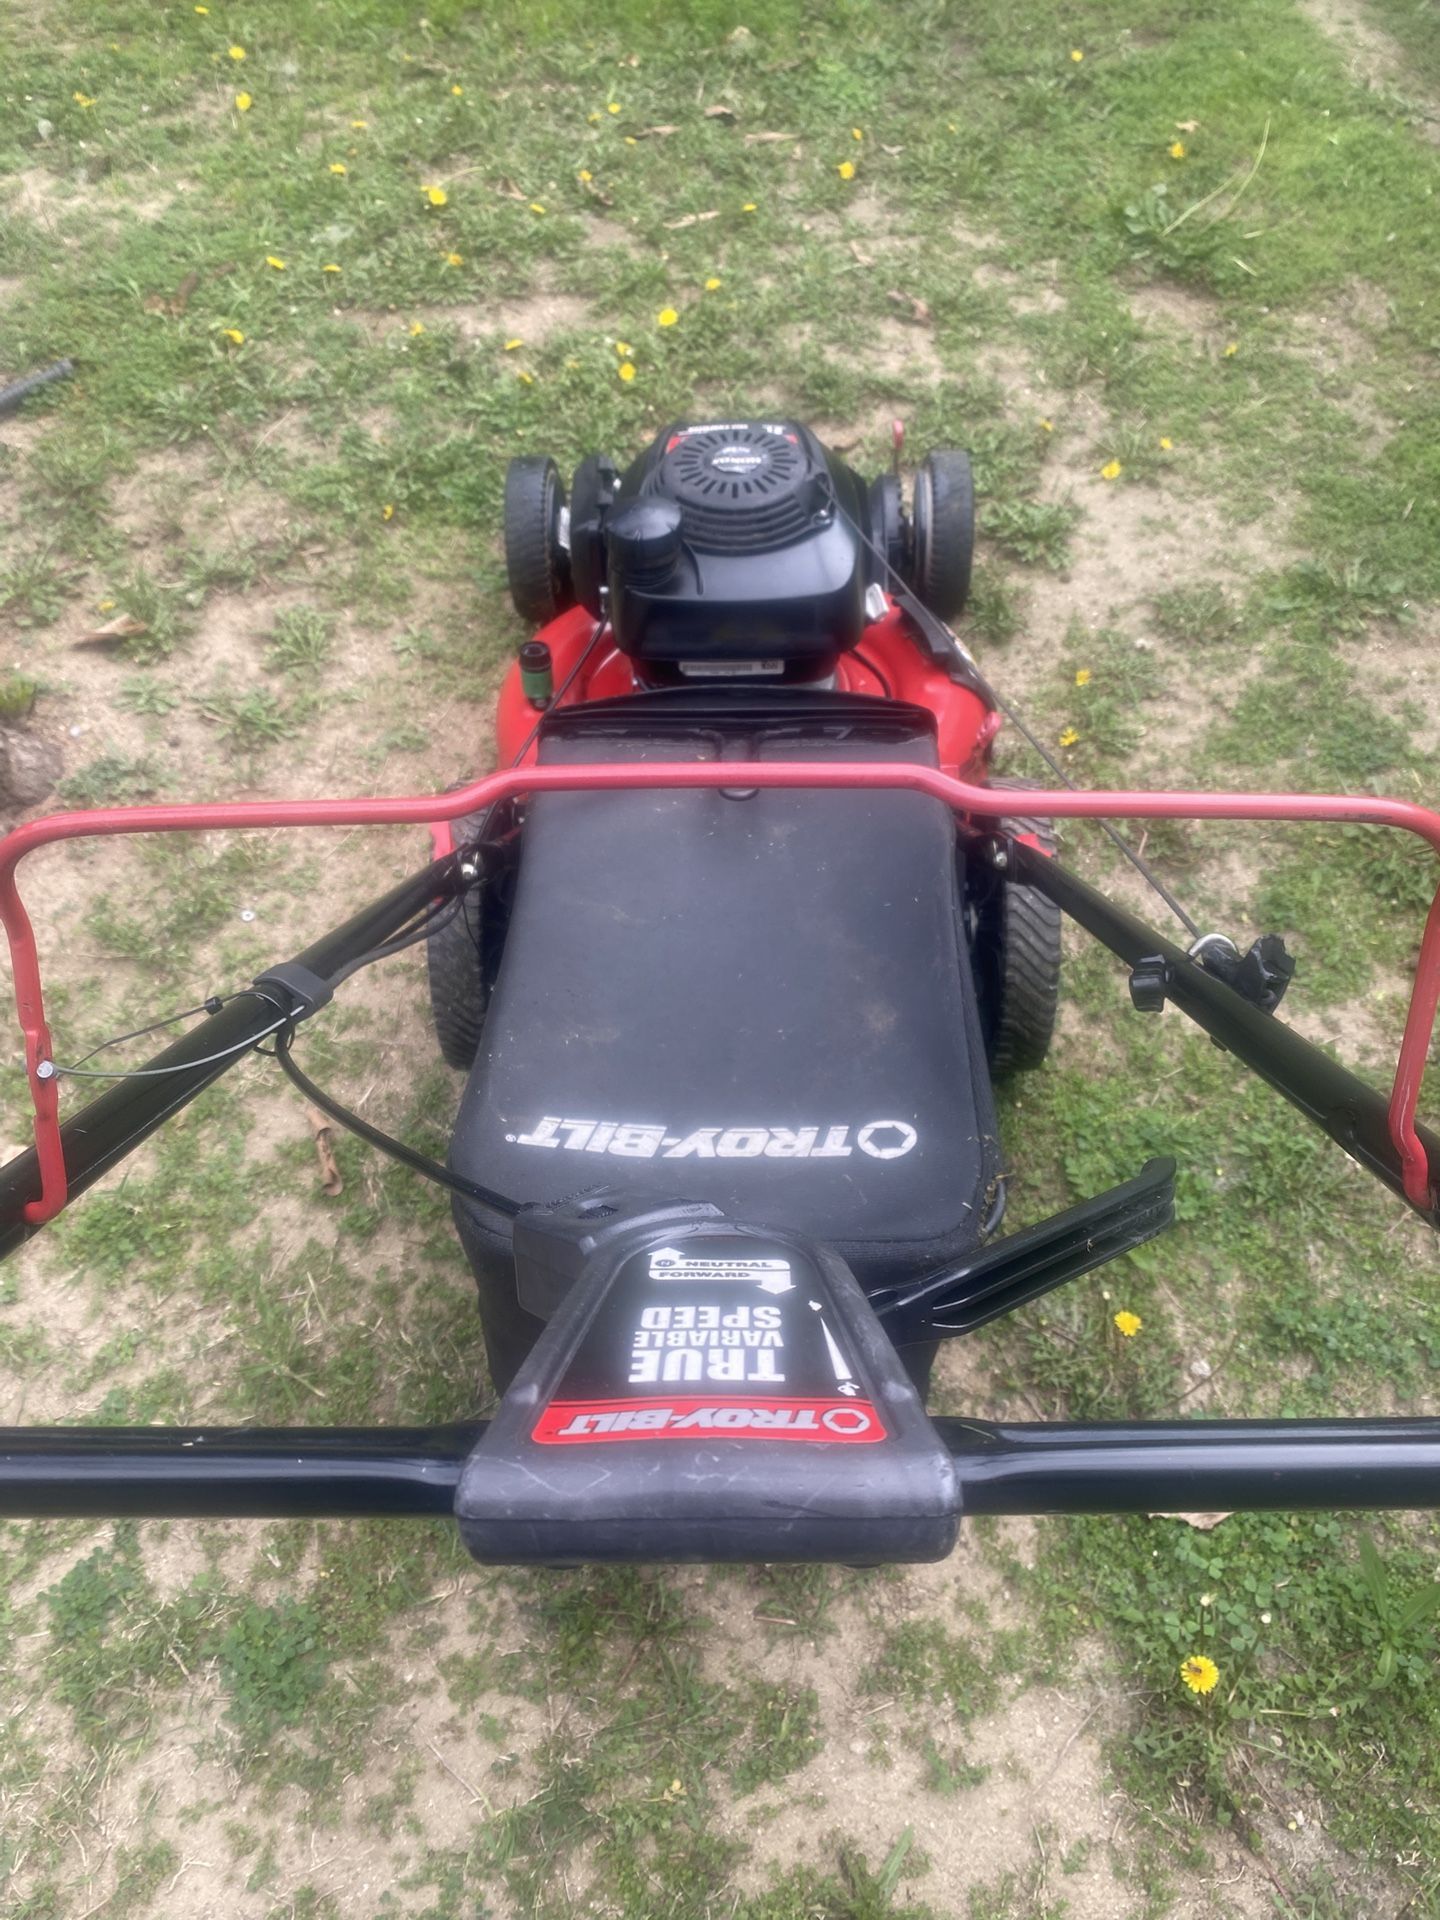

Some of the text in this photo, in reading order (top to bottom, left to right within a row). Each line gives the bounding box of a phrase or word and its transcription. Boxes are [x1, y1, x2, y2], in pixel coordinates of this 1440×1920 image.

[516, 1116, 853, 1158] TROY-BILT
[640, 1306, 783, 1329] SPEED
[633, 1330, 785, 1348] VARIABLE
[628, 1348, 786, 1383] TRUE
[558, 1408, 820, 1435] TROY-BILT
